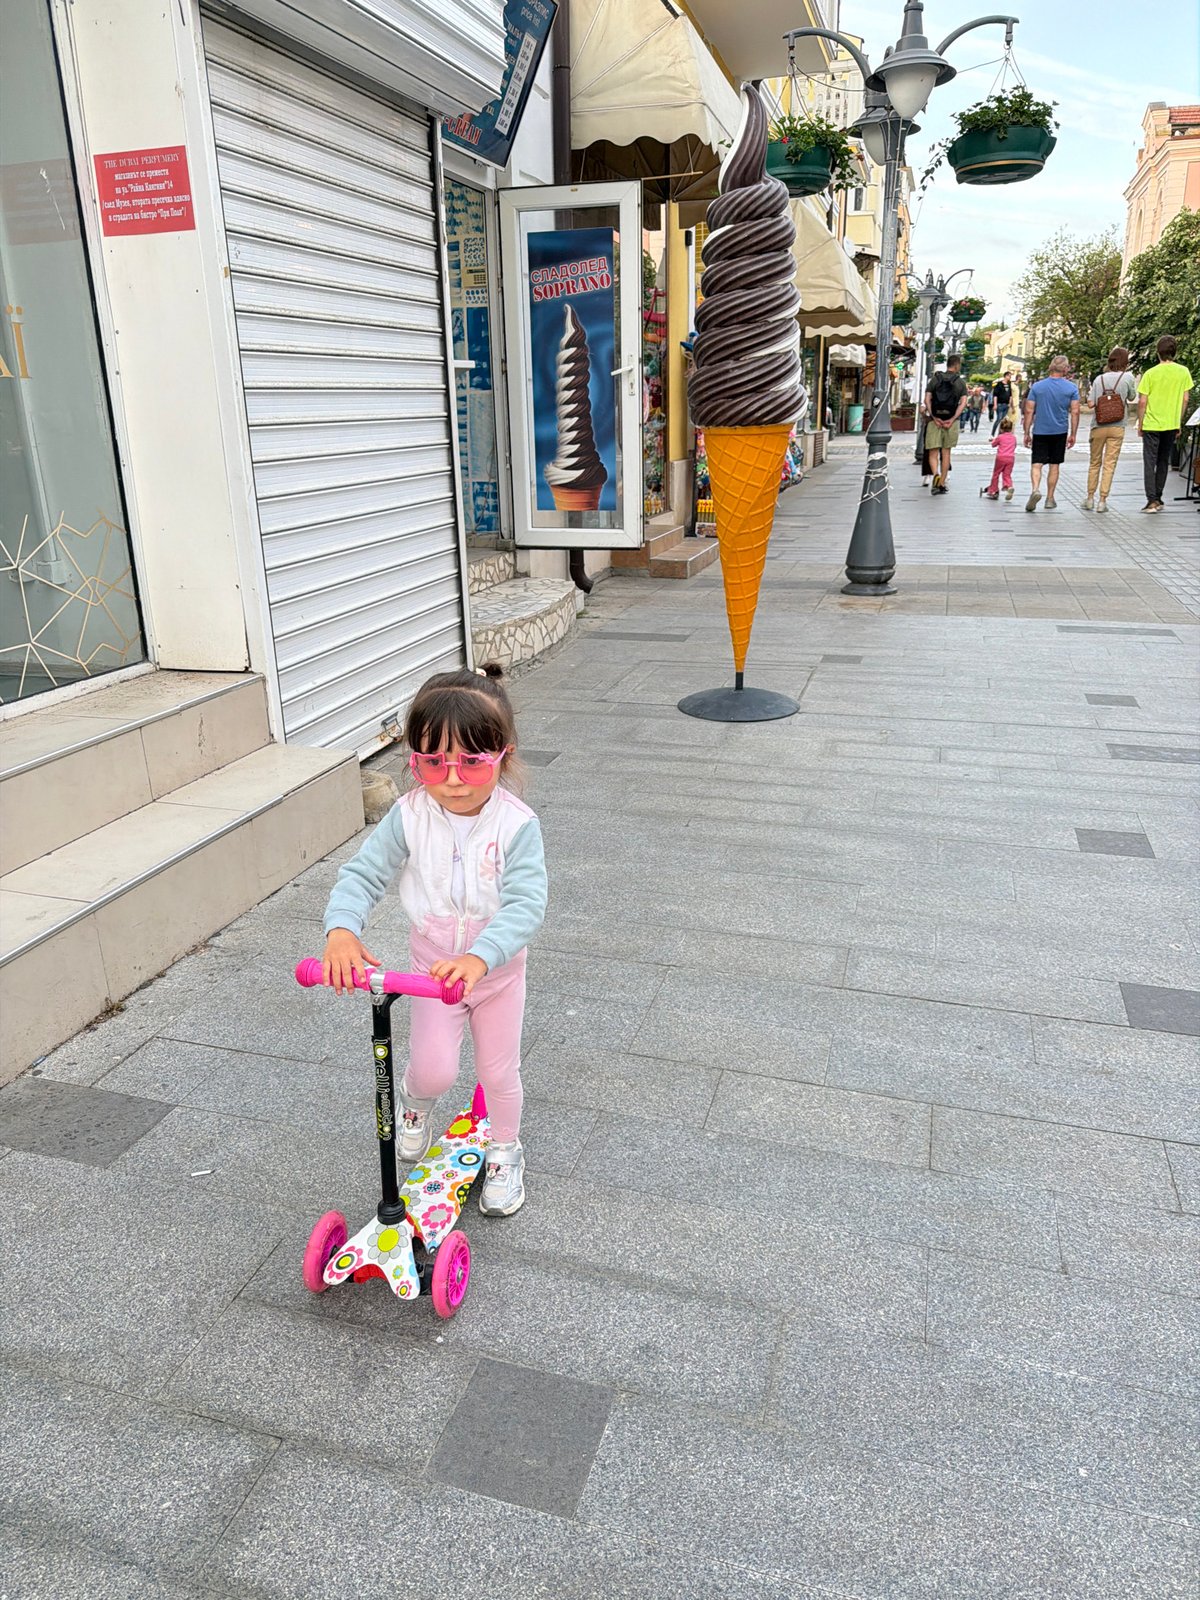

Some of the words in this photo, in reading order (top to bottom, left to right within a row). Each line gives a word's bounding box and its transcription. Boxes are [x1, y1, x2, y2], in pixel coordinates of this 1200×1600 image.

[104, 160, 117, 168] THE
[119, 157, 139, 168] DUBAI
[141, 153, 179, 164] PERFUMERY
[531, 257, 608, 284] СЛАДОЛЕД
[533, 273, 611, 302] SOPRANO
